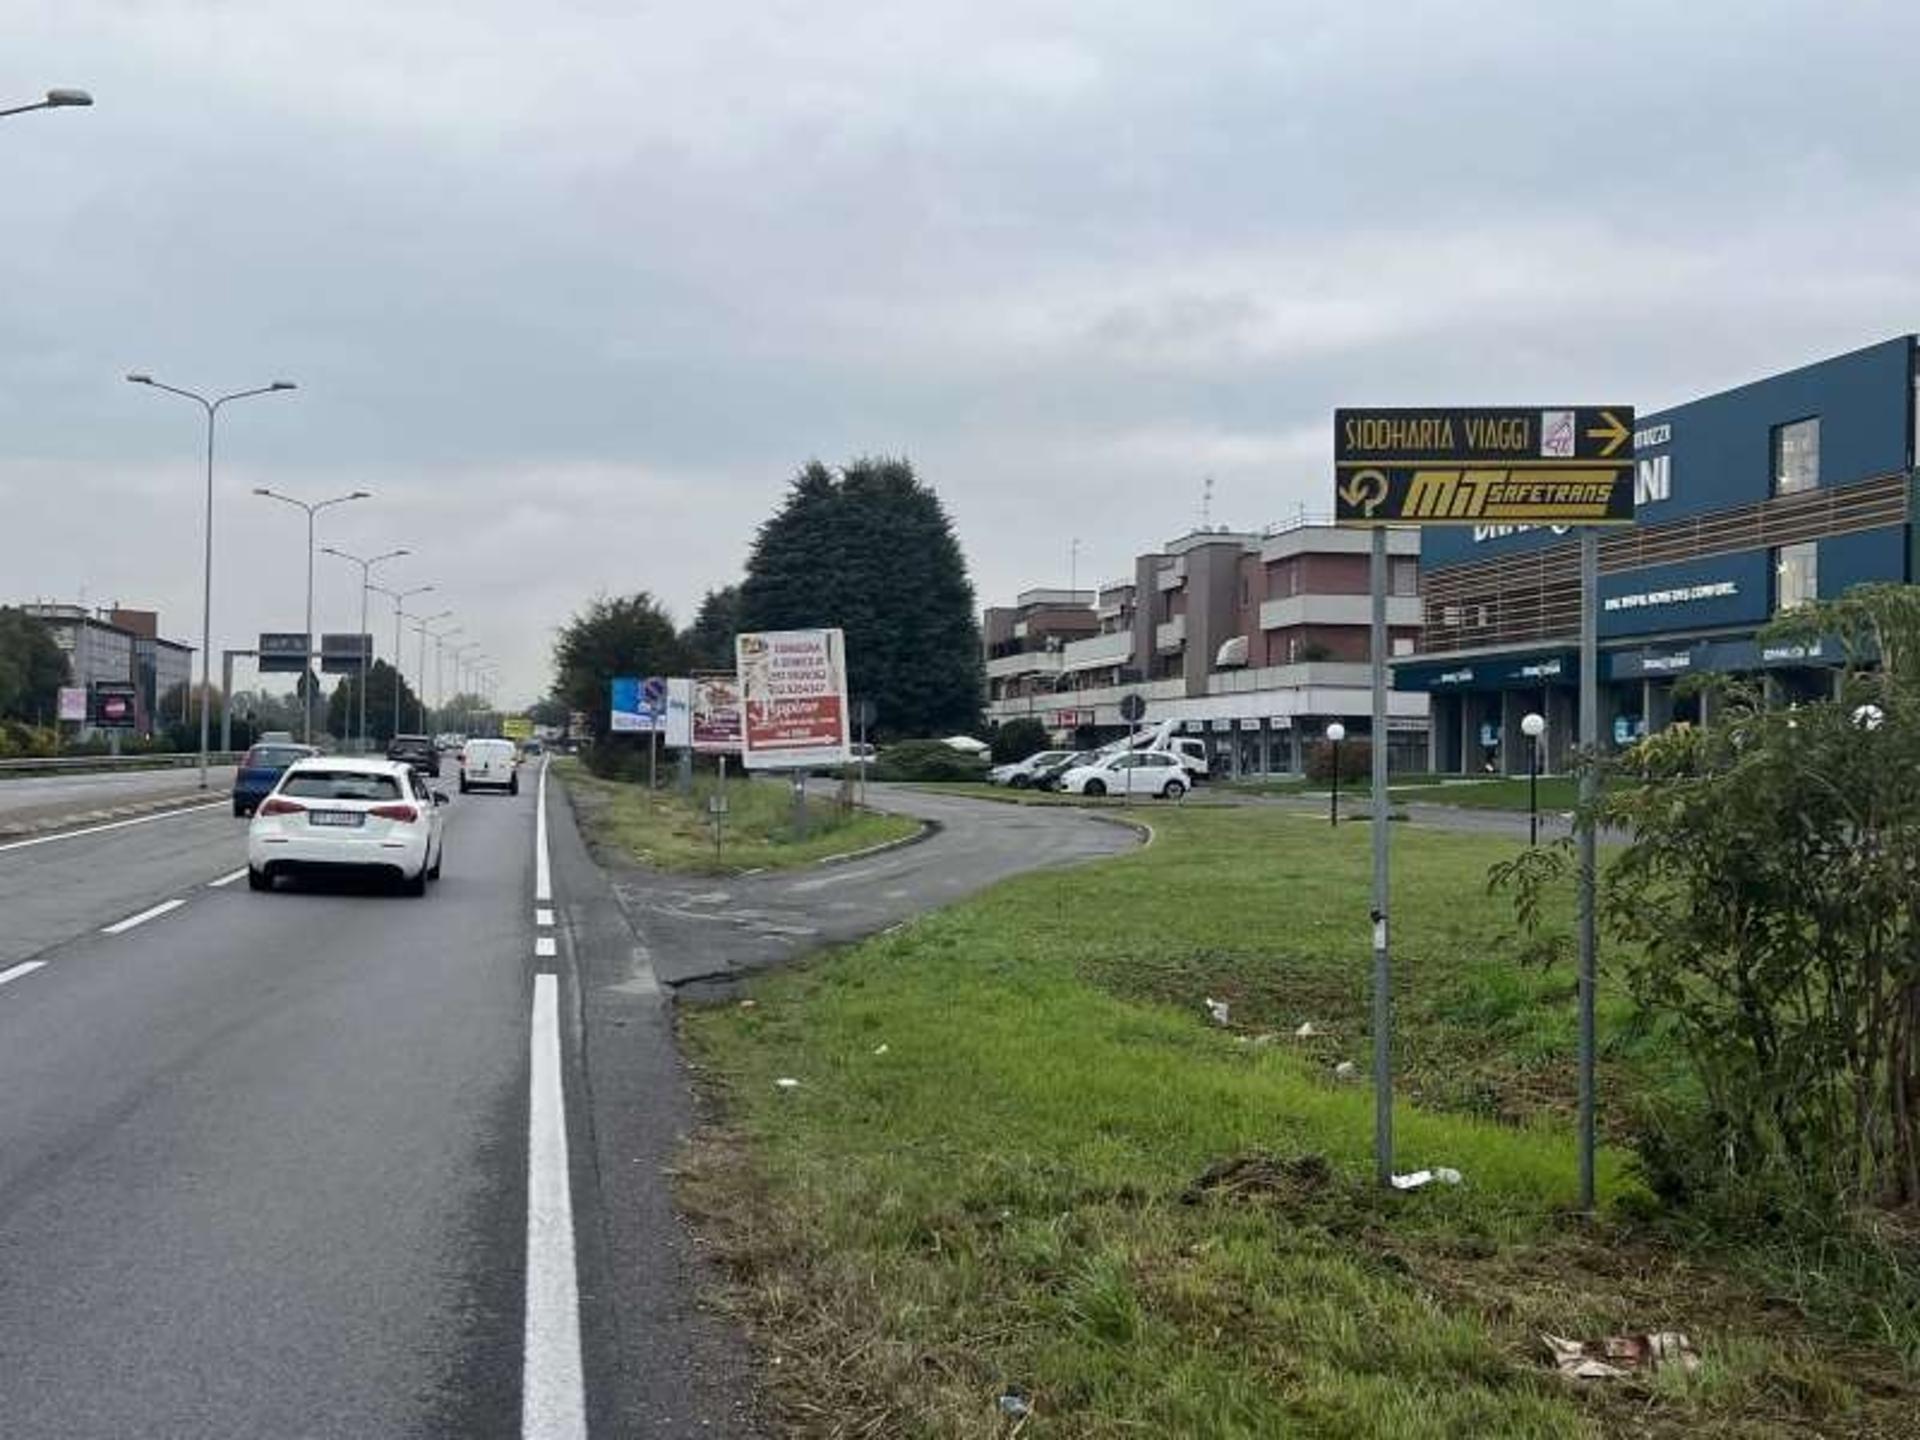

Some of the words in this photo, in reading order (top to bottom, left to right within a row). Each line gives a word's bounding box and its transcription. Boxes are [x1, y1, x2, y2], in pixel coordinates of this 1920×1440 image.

[1345, 419, 1455, 450] SIDDHARTA
[1464, 418, 1530, 450] VIAGGI
[1488, 483, 1614, 504] SAFETRANS
